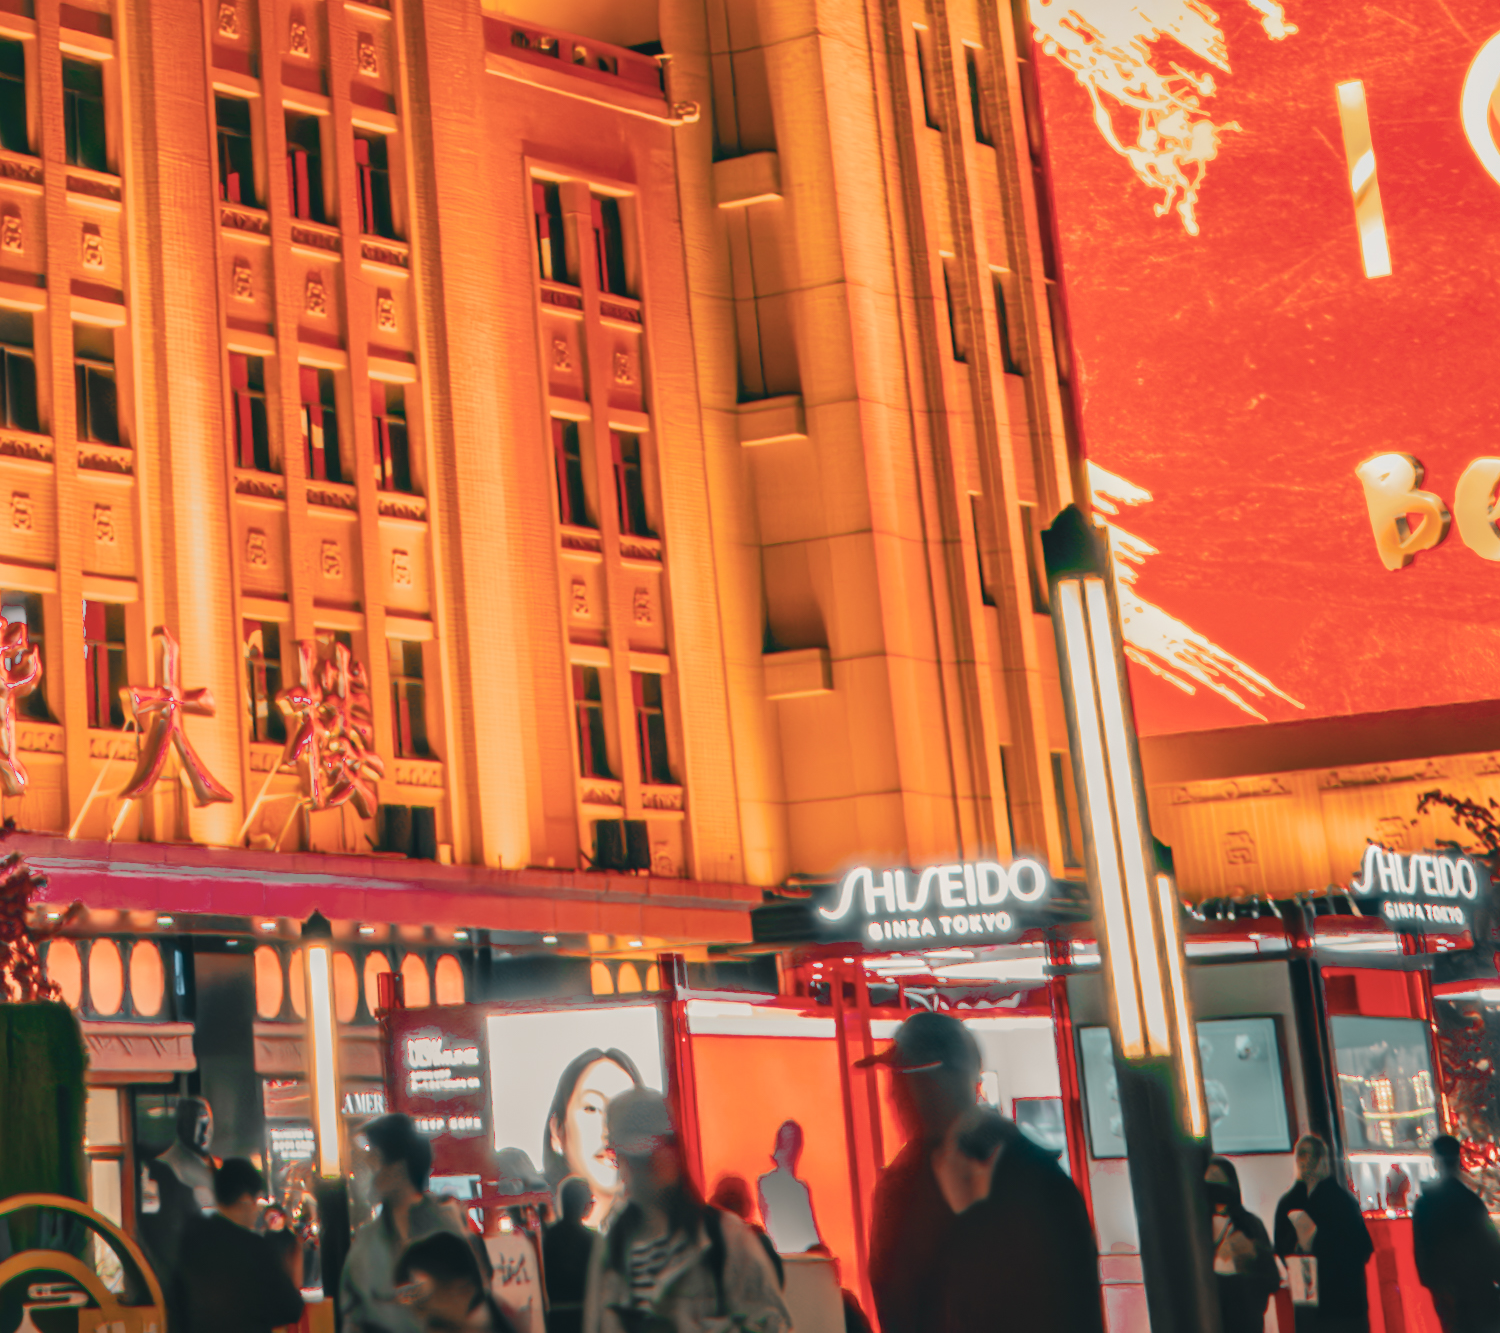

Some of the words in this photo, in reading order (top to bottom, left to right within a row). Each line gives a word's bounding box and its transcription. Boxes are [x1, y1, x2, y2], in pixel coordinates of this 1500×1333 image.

[1334, 79, 1392, 279] I
[818, 858, 1048, 921] SHISEIDO
[1351, 844, 1478, 900] SHISEIDO
[868, 917, 936, 942] GINZA
[938, 911, 1013, 936] TOKYO
[1384, 900, 1425, 921] GINZA
